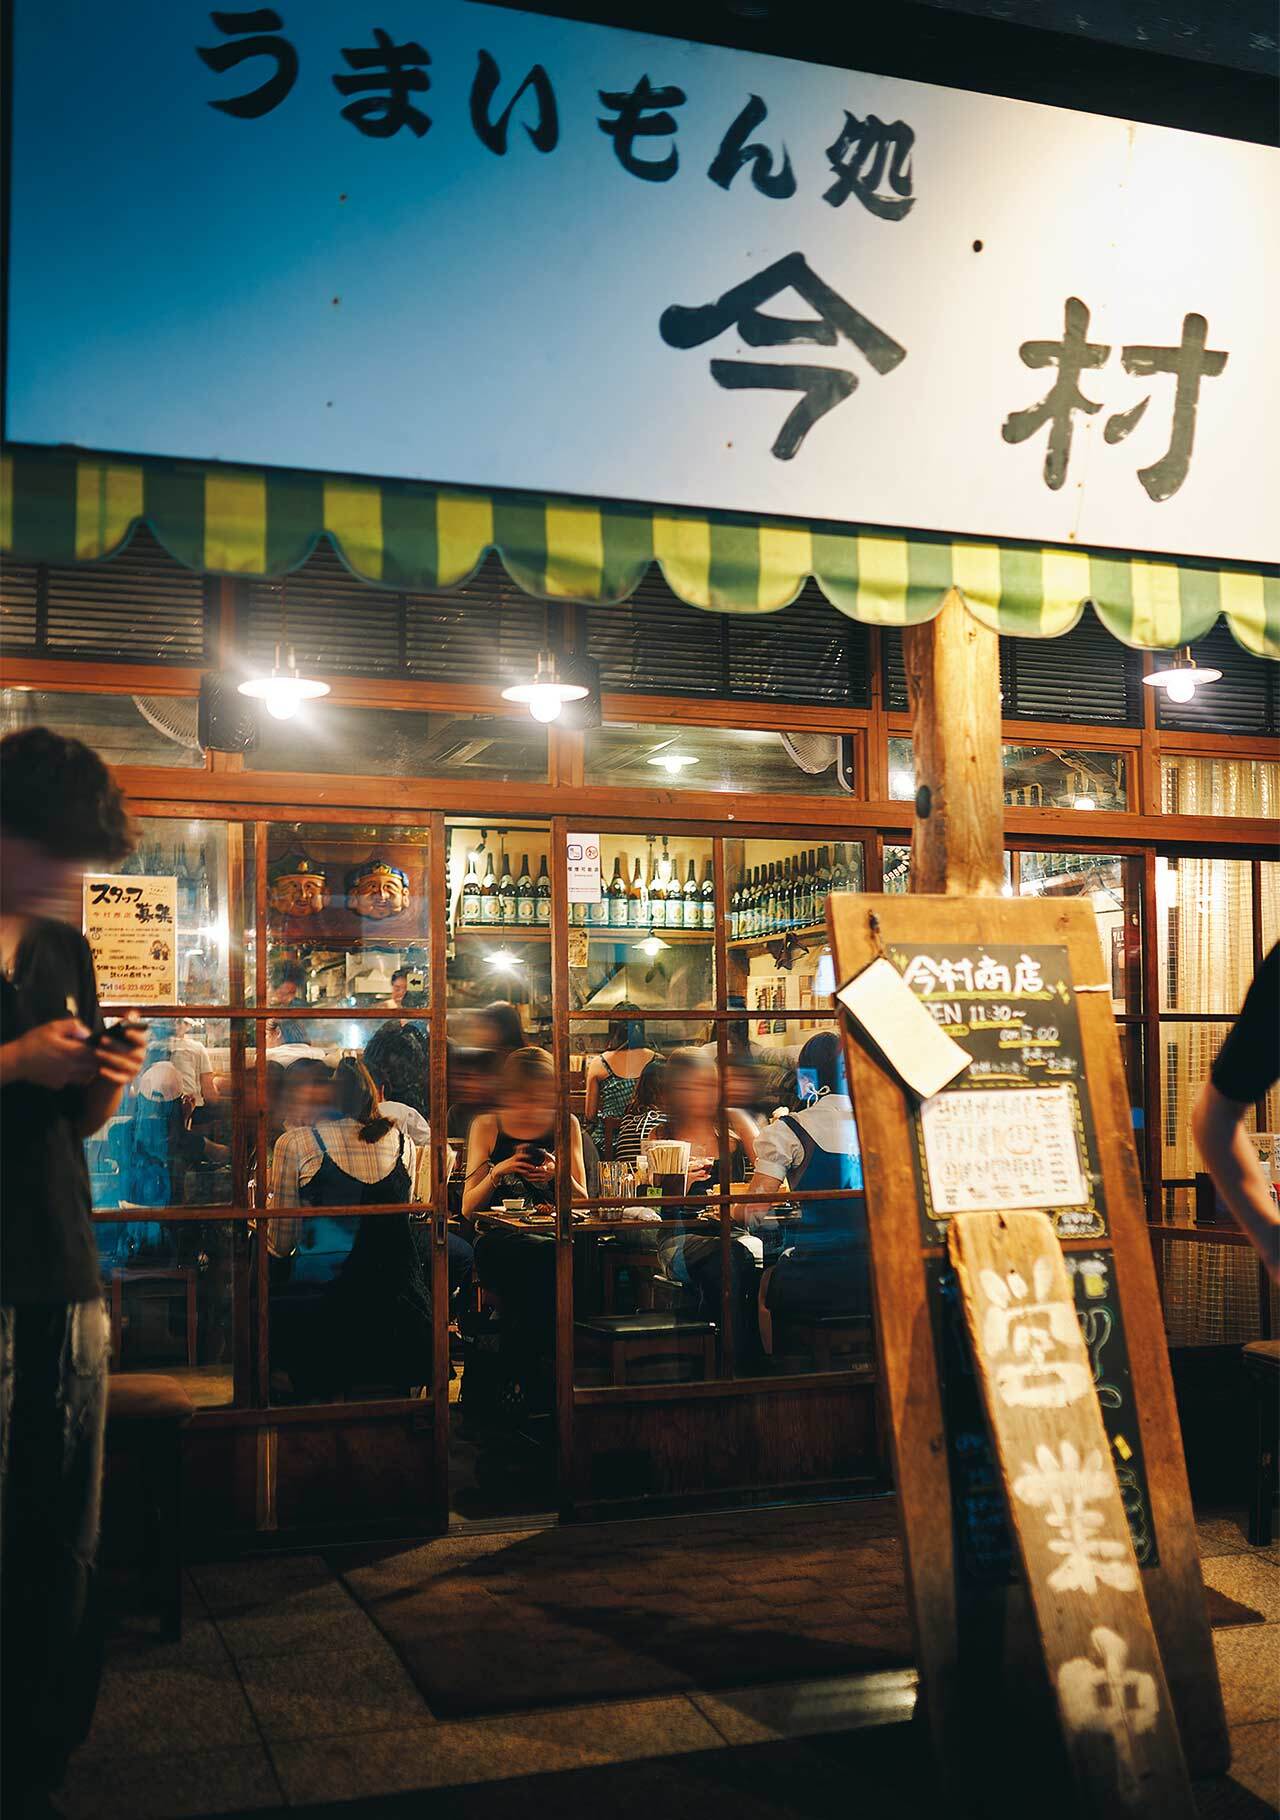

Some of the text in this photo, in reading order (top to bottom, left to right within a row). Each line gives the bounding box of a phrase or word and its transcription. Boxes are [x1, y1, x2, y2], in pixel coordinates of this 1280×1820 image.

[196, 9, 917, 222] うまいもん処
[658, 251, 1229, 503] 今村
[90, 884, 143, 904] スタッフ
[135, 903, 173, 923] 募集
[902, 954, 1043, 997] 今村商店
[925, 1002, 963, 1024] EN
